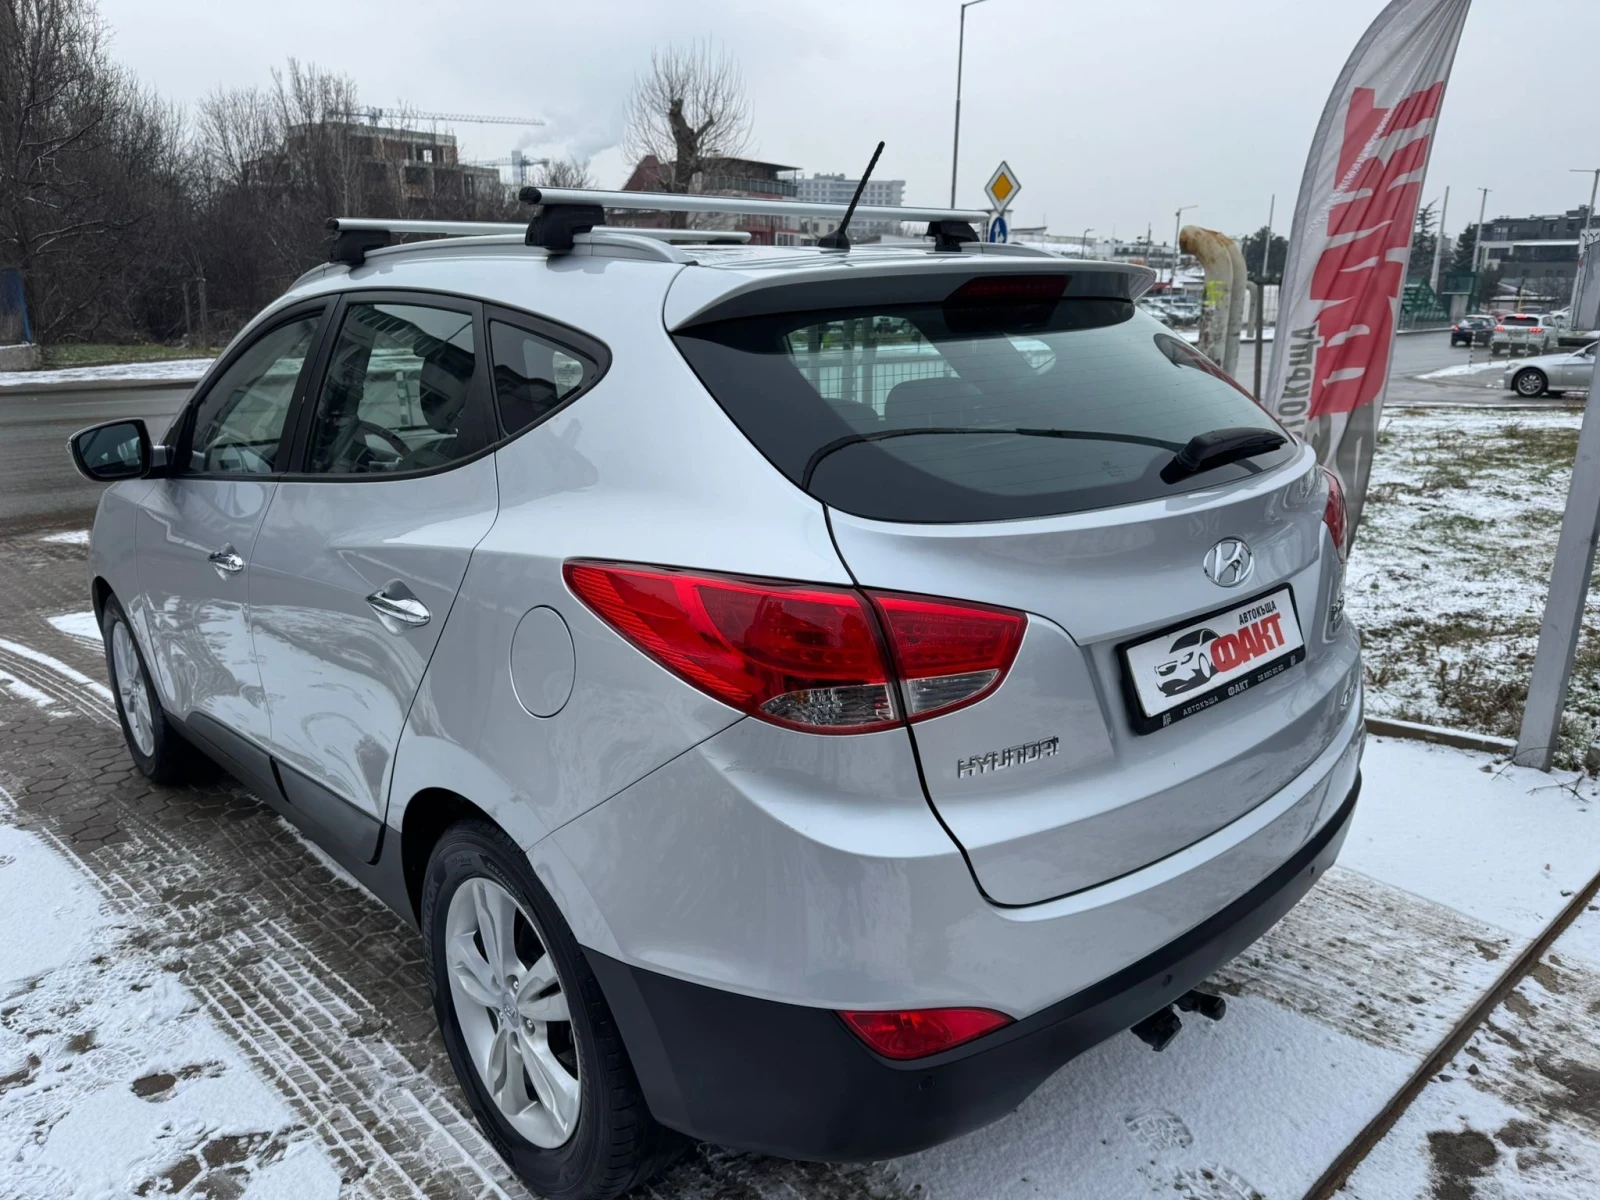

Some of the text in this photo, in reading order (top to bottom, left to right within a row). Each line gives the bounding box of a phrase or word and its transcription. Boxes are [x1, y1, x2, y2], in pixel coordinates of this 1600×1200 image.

[1309, 81, 1445, 418] ФАКТ
[1238, 600, 1278, 626] АВТОКЪЩА
[1210, 612, 1286, 673] ФАКТ
[1182, 680, 1250, 716] АВТОКЪЩА ФАКТ
[957, 735, 1060, 779] HYUNDAI
